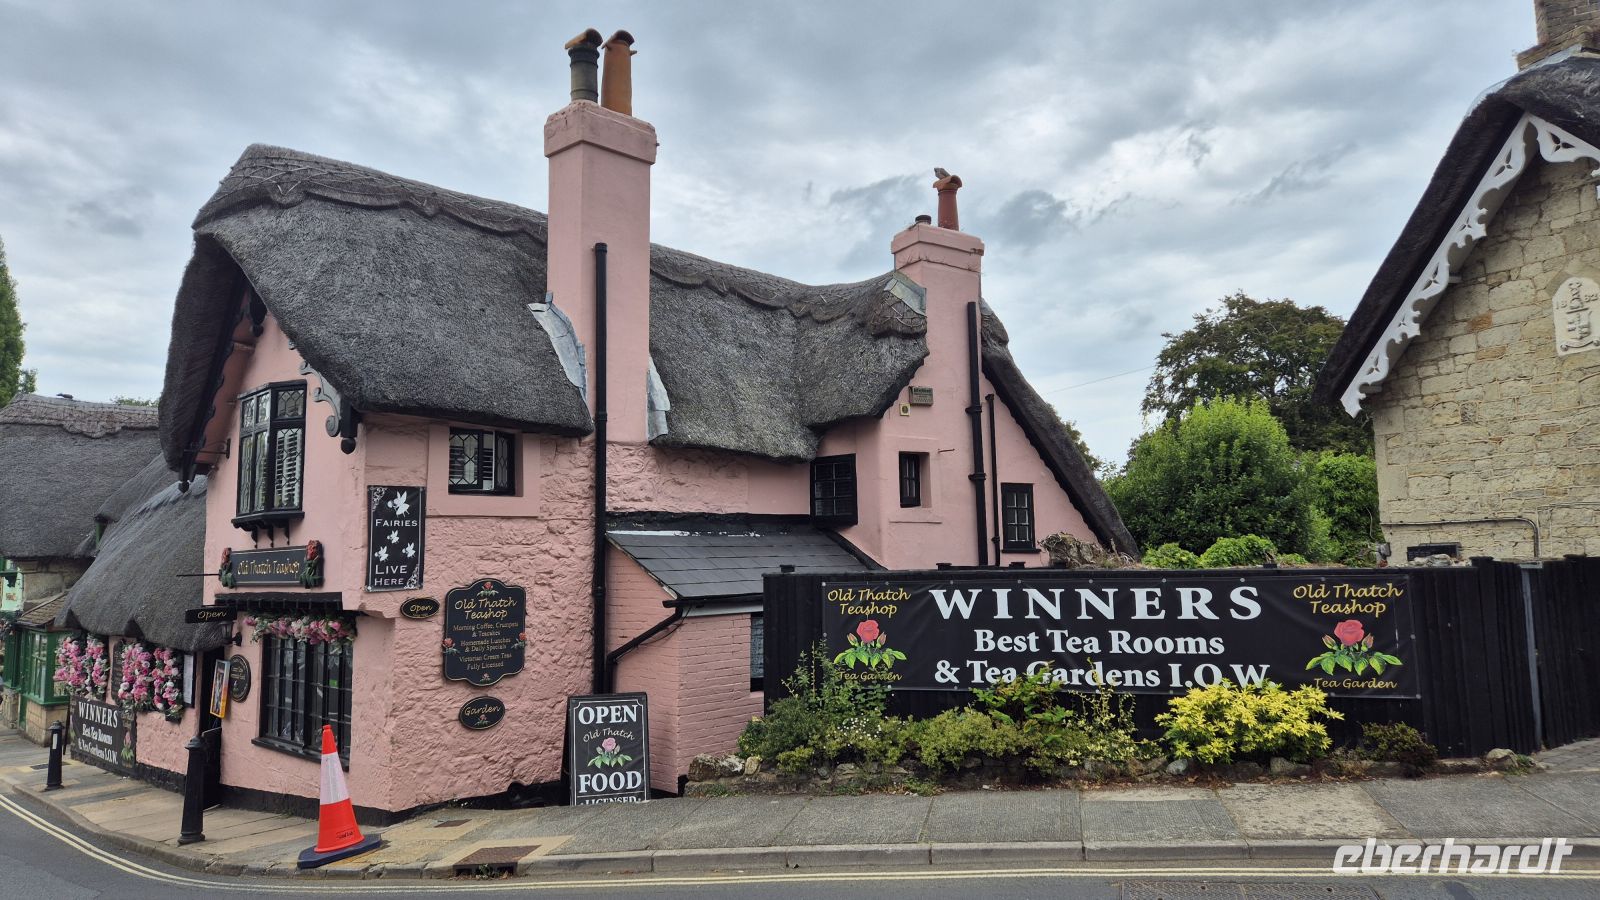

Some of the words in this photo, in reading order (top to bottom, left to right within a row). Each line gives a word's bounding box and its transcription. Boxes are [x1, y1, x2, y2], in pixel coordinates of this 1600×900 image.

[375, 518, 418, 527] FAIRIES
[375, 564, 408, 575] LIVE
[374, 577, 404, 586] HERE
[827, 588, 856, 602] Old
[858, 587, 912, 601] Thatch
[1293, 584, 1331, 599] Old
[1333, 583, 1404, 598] Thatch
[410, 604, 433, 614] Open
[454, 598, 477, 610] Old
[478, 596, 517, 608] Thatch
[840, 602, 898, 619] Teashop
[928, 586, 1262, 621] WINNERS
[1309, 599, 1387, 618] Teashop
[197, 610, 227, 621] Open
[464, 608, 508, 621] Teashop
[974, 629, 1040, 653] Best
[1046, 629, 1101, 654] Tea
[1108, 630, 1225, 655] Rooms
[839, 671, 859, 681] Tea
[860, 671, 903, 682] Gaen
[934, 660, 960, 684] &
[966, 660, 1017, 685] Tea
[1027, 660, 1161, 688] Gardens
[1314, 678, 1341, 688] Tea
[1343, 678, 1398, 689] Garden
[78, 701, 119, 728] WINNERS
[464, 704, 501, 716] Garden
[578, 704, 639, 725] OPEN
[82, 723, 91, 737] Best
[98, 728, 113, 745] Rooms
[583, 729, 602, 742] Old
[602, 727, 636, 741] Thatch
[578, 770, 642, 793] FOOD
